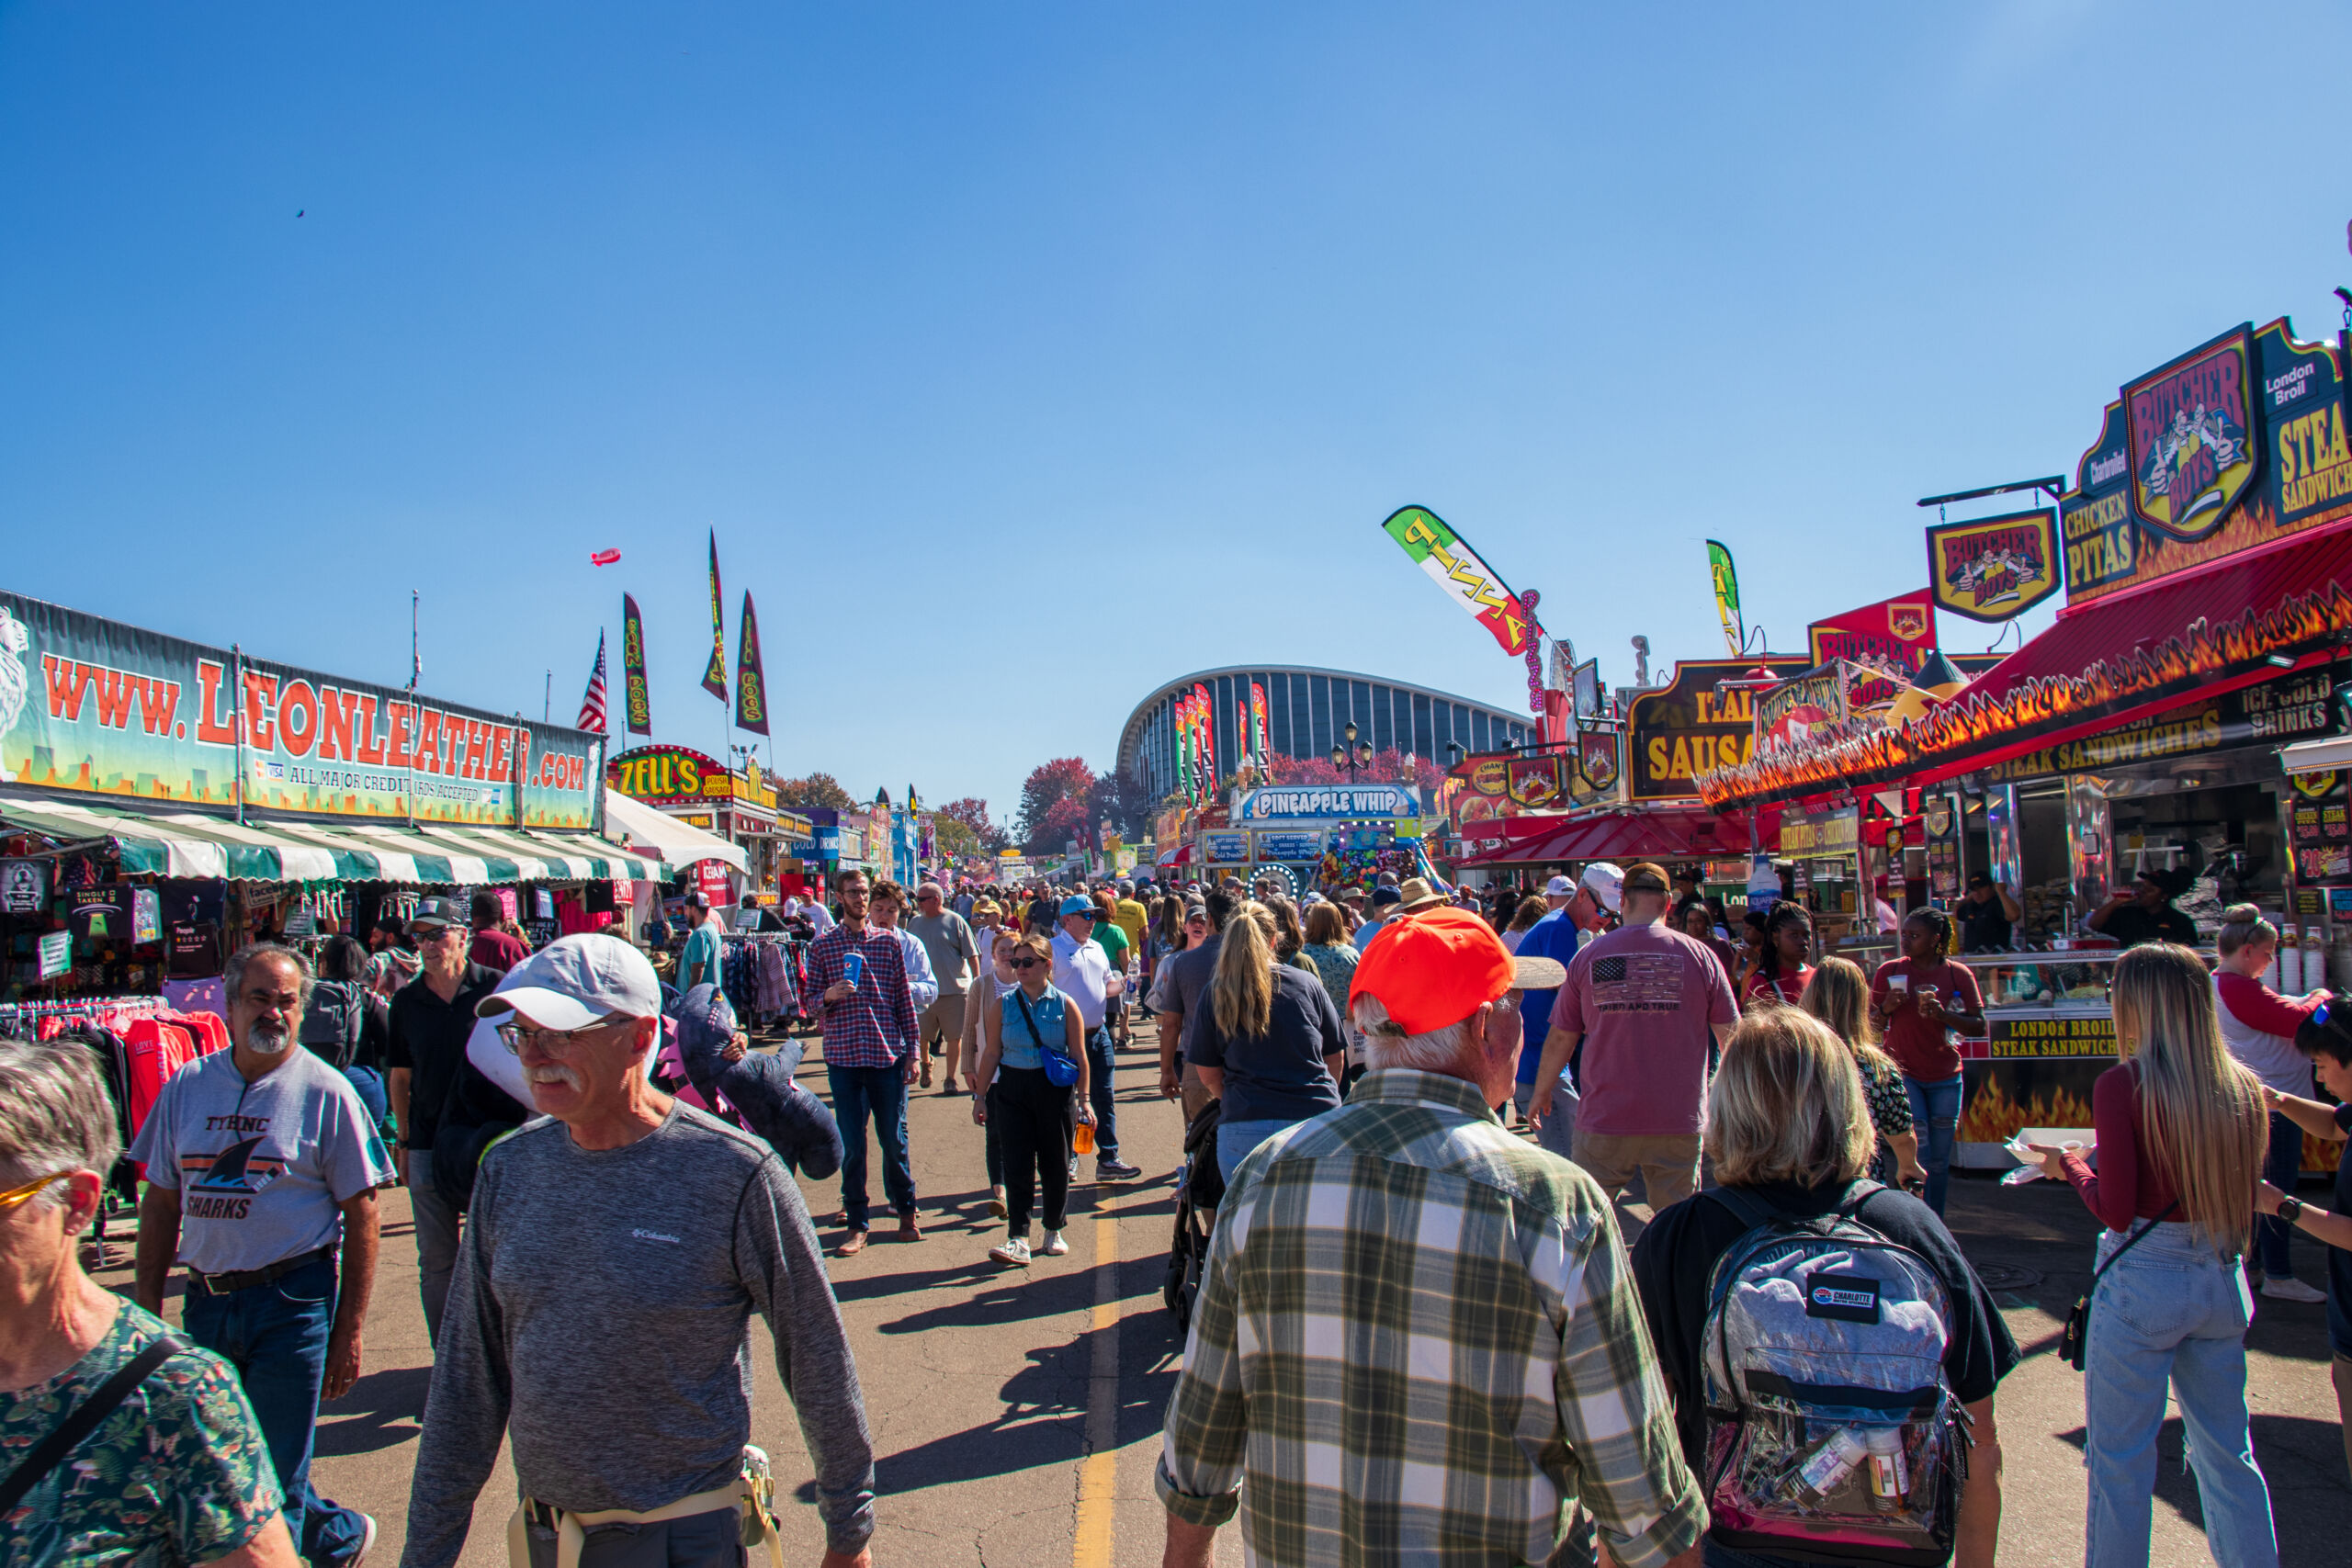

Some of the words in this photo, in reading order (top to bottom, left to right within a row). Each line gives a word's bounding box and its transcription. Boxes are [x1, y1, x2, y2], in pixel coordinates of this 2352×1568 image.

[2266, 363, 2314, 394] London
[2275, 380, 2306, 407] Broil
[2134, 349, 2245, 462] BUTCHER
[2090, 448, 2126, 485] Charbroiled
[2168, 444, 2217, 525] BOYS
[2064, 491, 2128, 538] CHICKEN
[1943, 524, 2044, 575] BUTCHER
[2069, 525, 2132, 588] PITAS
[1974, 573, 2017, 607] BOYS
[626, 618, 642, 668] CORN
[1819, 633, 1921, 673] BUTCHER
[629, 674, 649, 726] DOGS
[742, 671, 763, 723] DOGS
[1852, 678, 1894, 706] BOYS
[2242, 684, 2273, 714] ICE
[2250, 701, 2330, 739] DRINKS
[1990, 753, 2056, 782] STEAK
[2058, 707, 2223, 771] SANDWICHES
[289, 767, 319, 785] ALL
[322, 771, 362, 793] MAJOR
[364, 774, 411, 795] CREDIT
[436, 784, 479, 802] ACCEPTED
[619, 753, 699, 795] ZELL'S
[1259, 791, 1351, 816] PINEAPPLE
[1351, 791, 1398, 813] WHIP
[793, 837, 816, 850] COLD
[1471, 840, 1497, 849] CLD
[76, 890, 107, 898] SINGLE
[1599, 1003, 1625, 1011] TRIED
[1628, 1002, 1649, 1011] AND
[1651, 1002, 1680, 1011] TRUE
[2010, 1021, 2067, 1038] LONDON
[2070, 1020, 2116, 1036] BROIL
[1992, 1040, 2039, 1056] STEAK
[2041, 1038, 2137, 1055] SANDWICHS
[187, 1197, 253, 1220] SHARKS
[1833, 1291, 1871, 1303] CHARLOTTE
